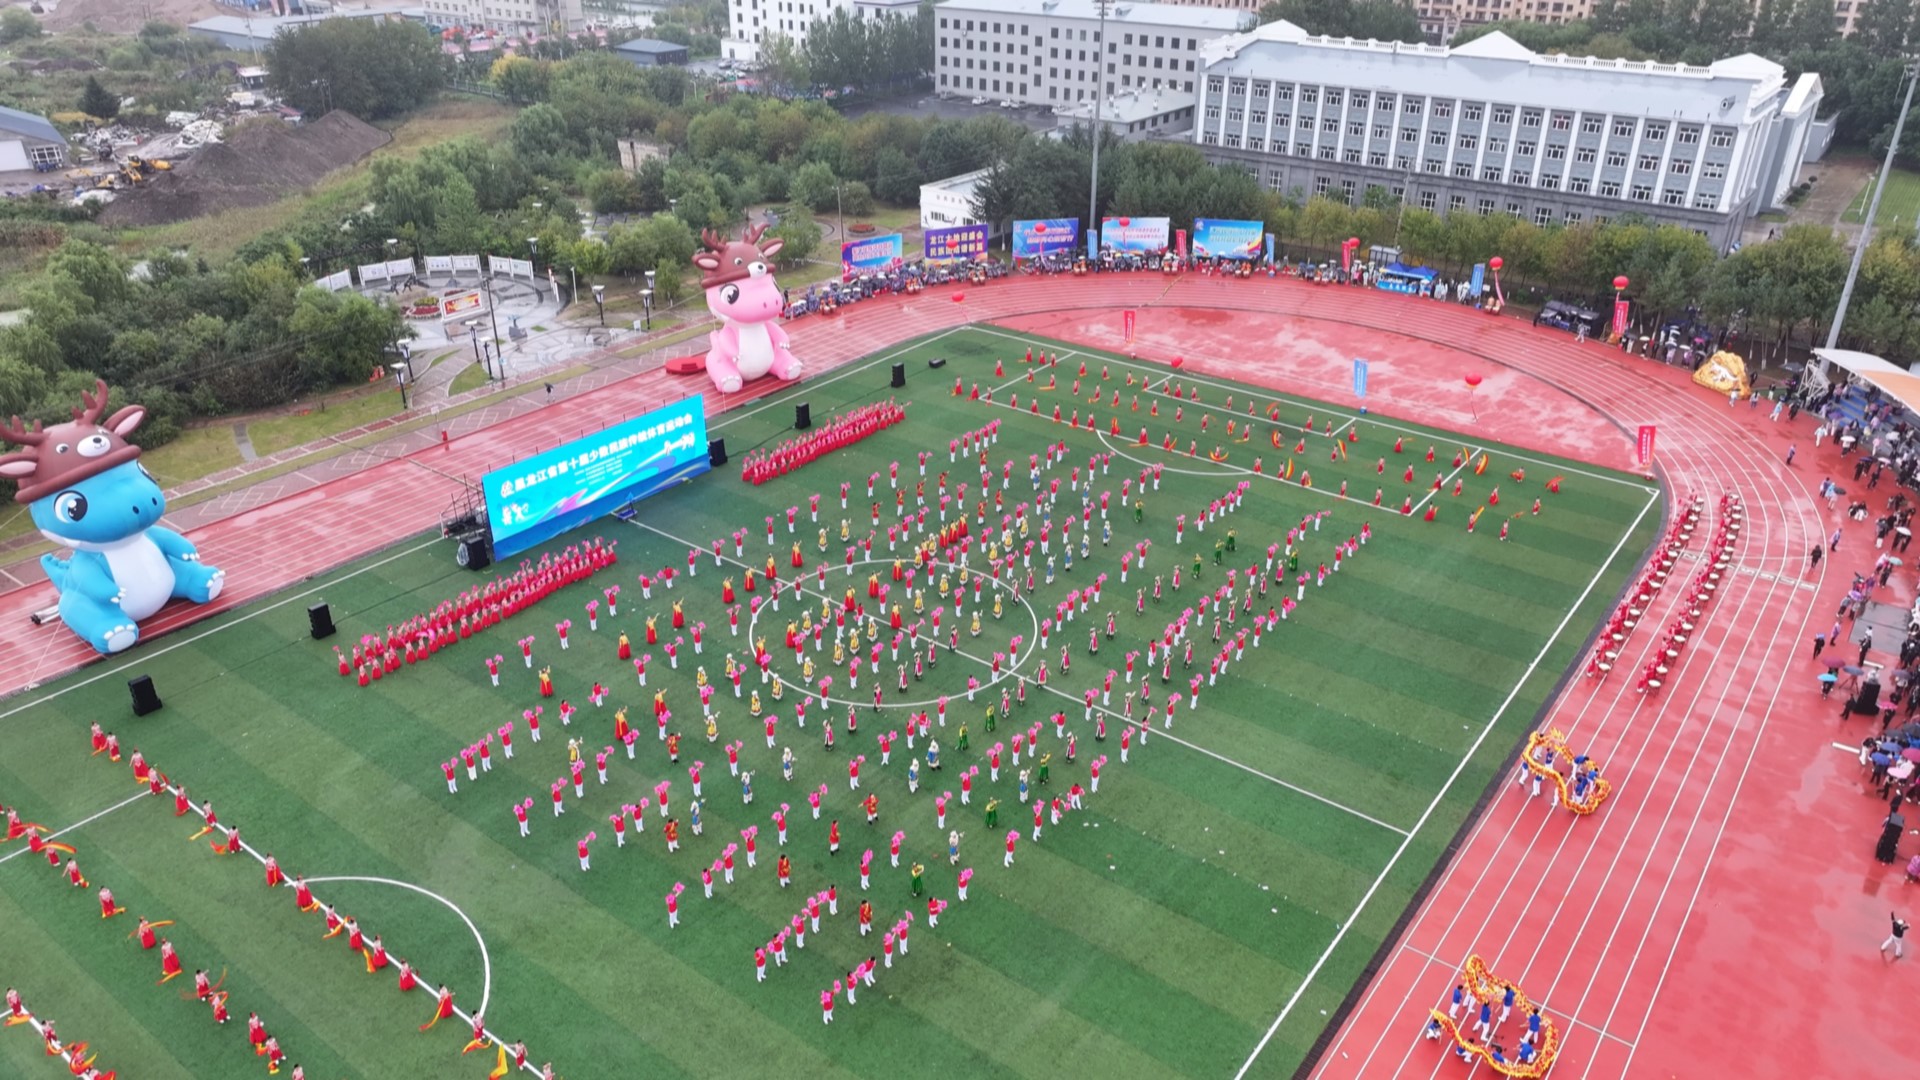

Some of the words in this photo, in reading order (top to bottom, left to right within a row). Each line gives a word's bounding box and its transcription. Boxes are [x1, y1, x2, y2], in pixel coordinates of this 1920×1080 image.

[514, 414, 692, 490] 黑龙江省第十届少数民族传统体育运动会
